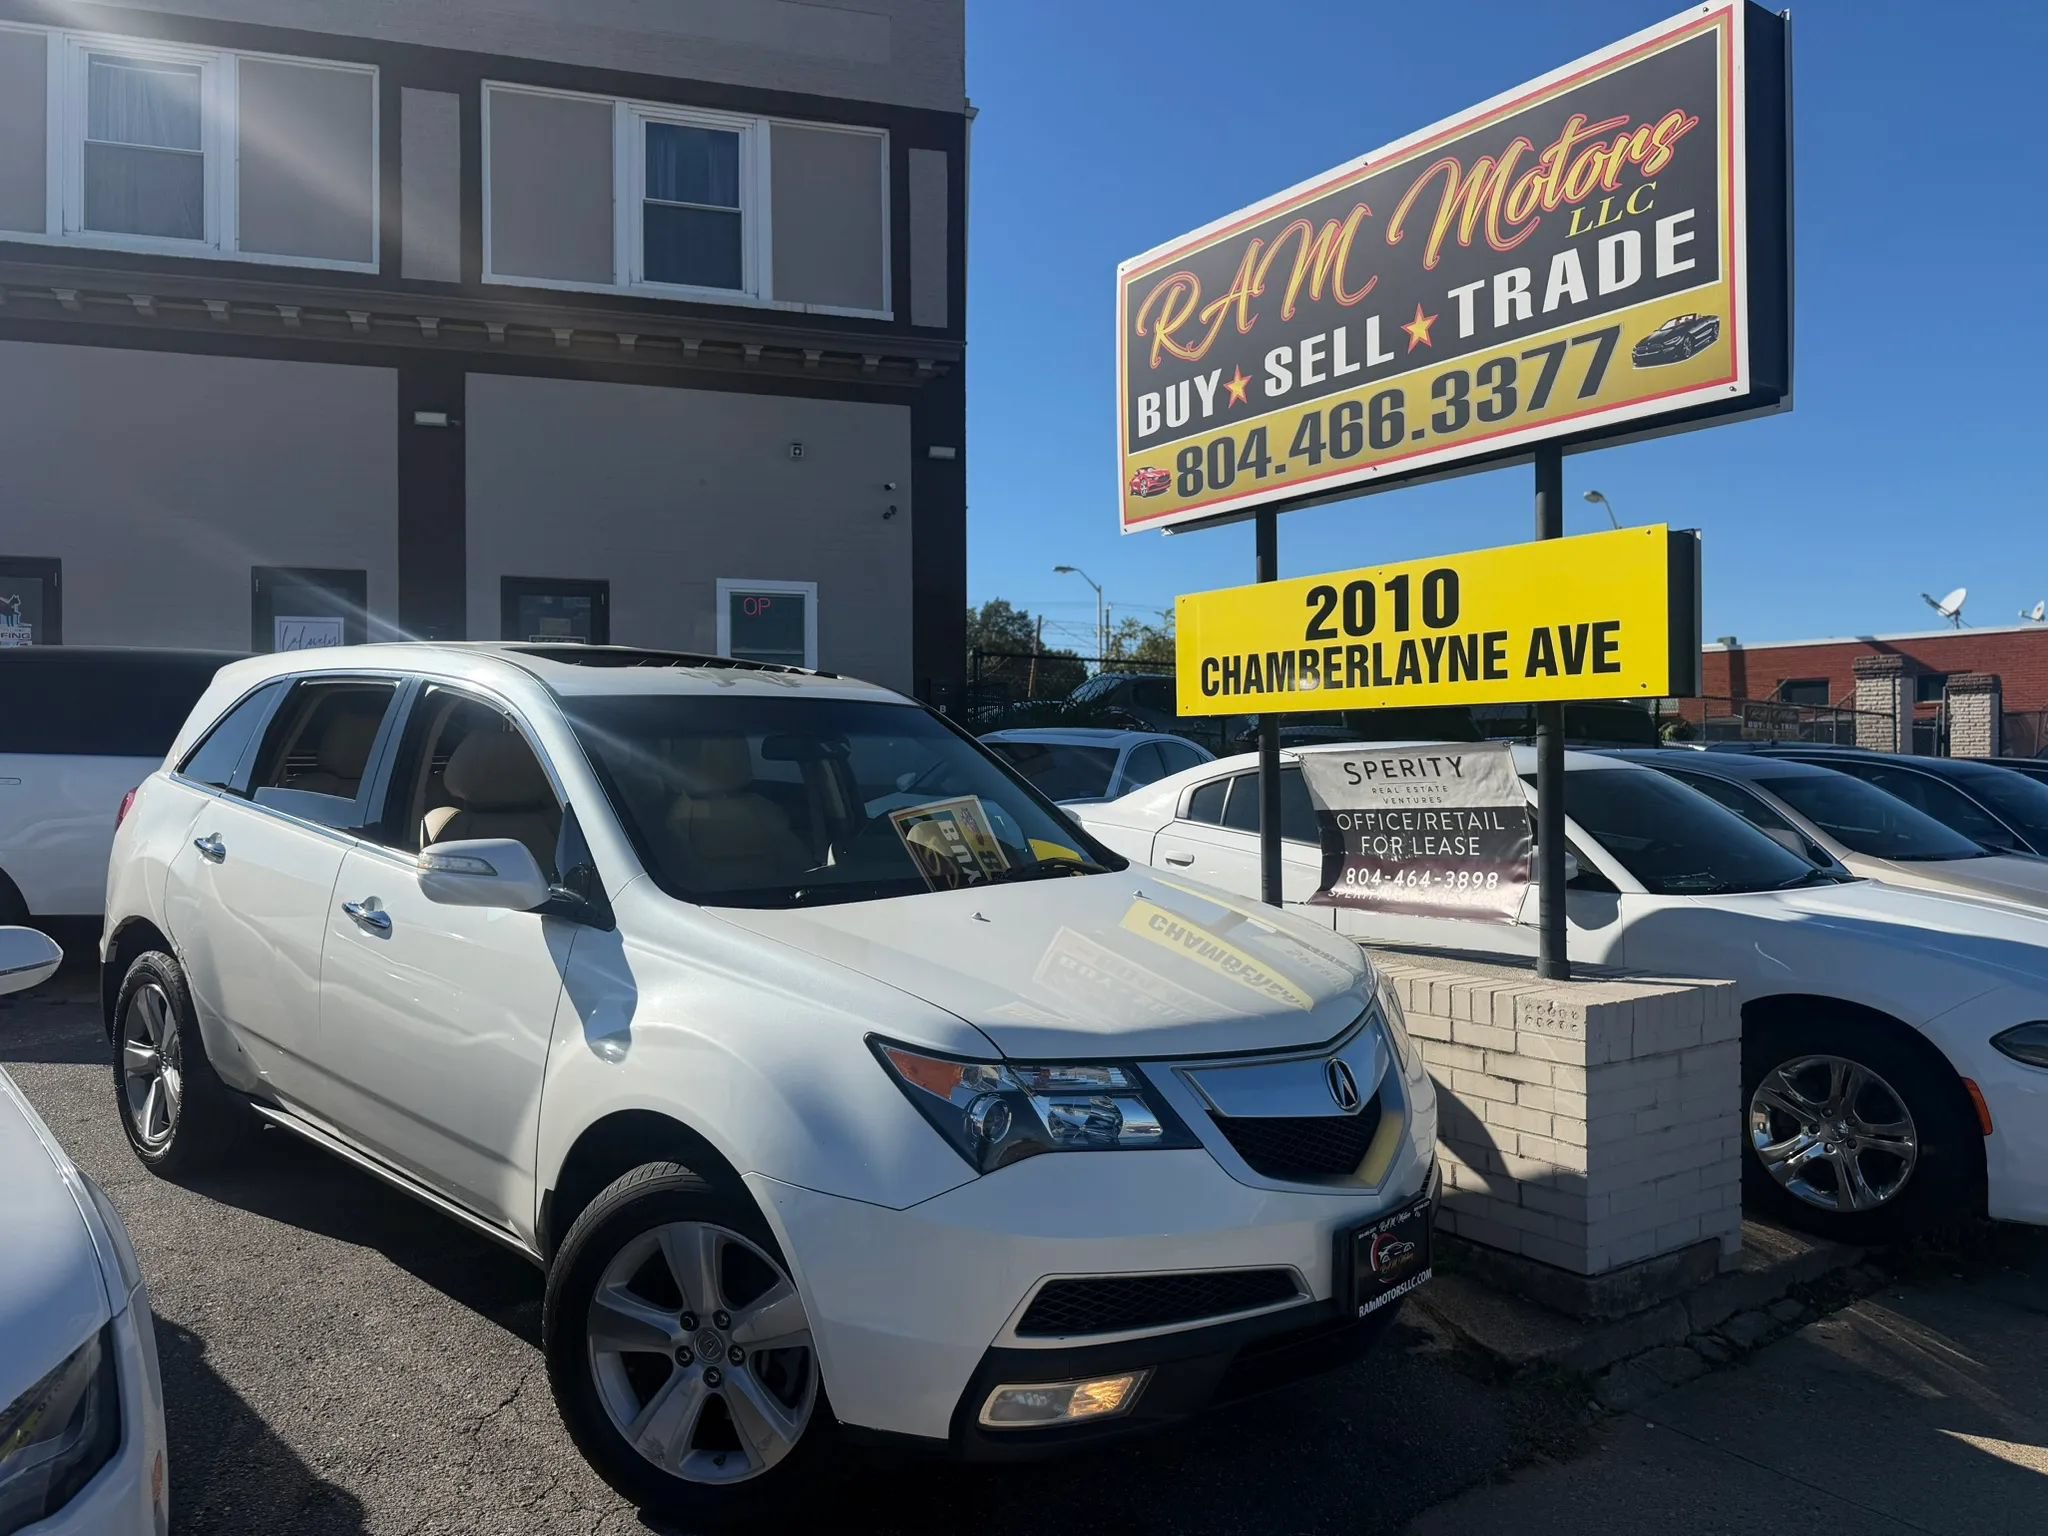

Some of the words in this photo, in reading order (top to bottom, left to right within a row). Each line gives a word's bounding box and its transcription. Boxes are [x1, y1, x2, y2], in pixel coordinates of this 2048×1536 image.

[1565, 181, 1656, 238] LLC
[1136, 203, 1378, 369] RAM
[1385, 109, 1699, 270] Motors
[1137, 367, 1223, 439] BUY
[1264, 314, 1395, 398] SELL
[1447, 208, 1696, 340] TRADE
[1176, 324, 1623, 498] 804.466.3377
[1304, 568, 1460, 641] 2010
[1201, 630, 1508, 697] CHAMBERLAYNE
[1524, 620, 1621, 678] AVE
[1343, 756, 1463, 785] SPERITY
[1371, 787, 1399, 795] REAL
[1406, 785, 1448, 793] ESTATE
[1336, 811, 1505, 831] OFFICE/RETAIL
[1383, 796, 1442, 805] VENTURES
[1360, 836, 1402, 856] FOR
[1412, 836, 1481, 856] LEASE
[1345, 867, 1499, 891] 804-464-3898
[1358, 1267, 1432, 1318] RAMMOTORSLLC.COM
